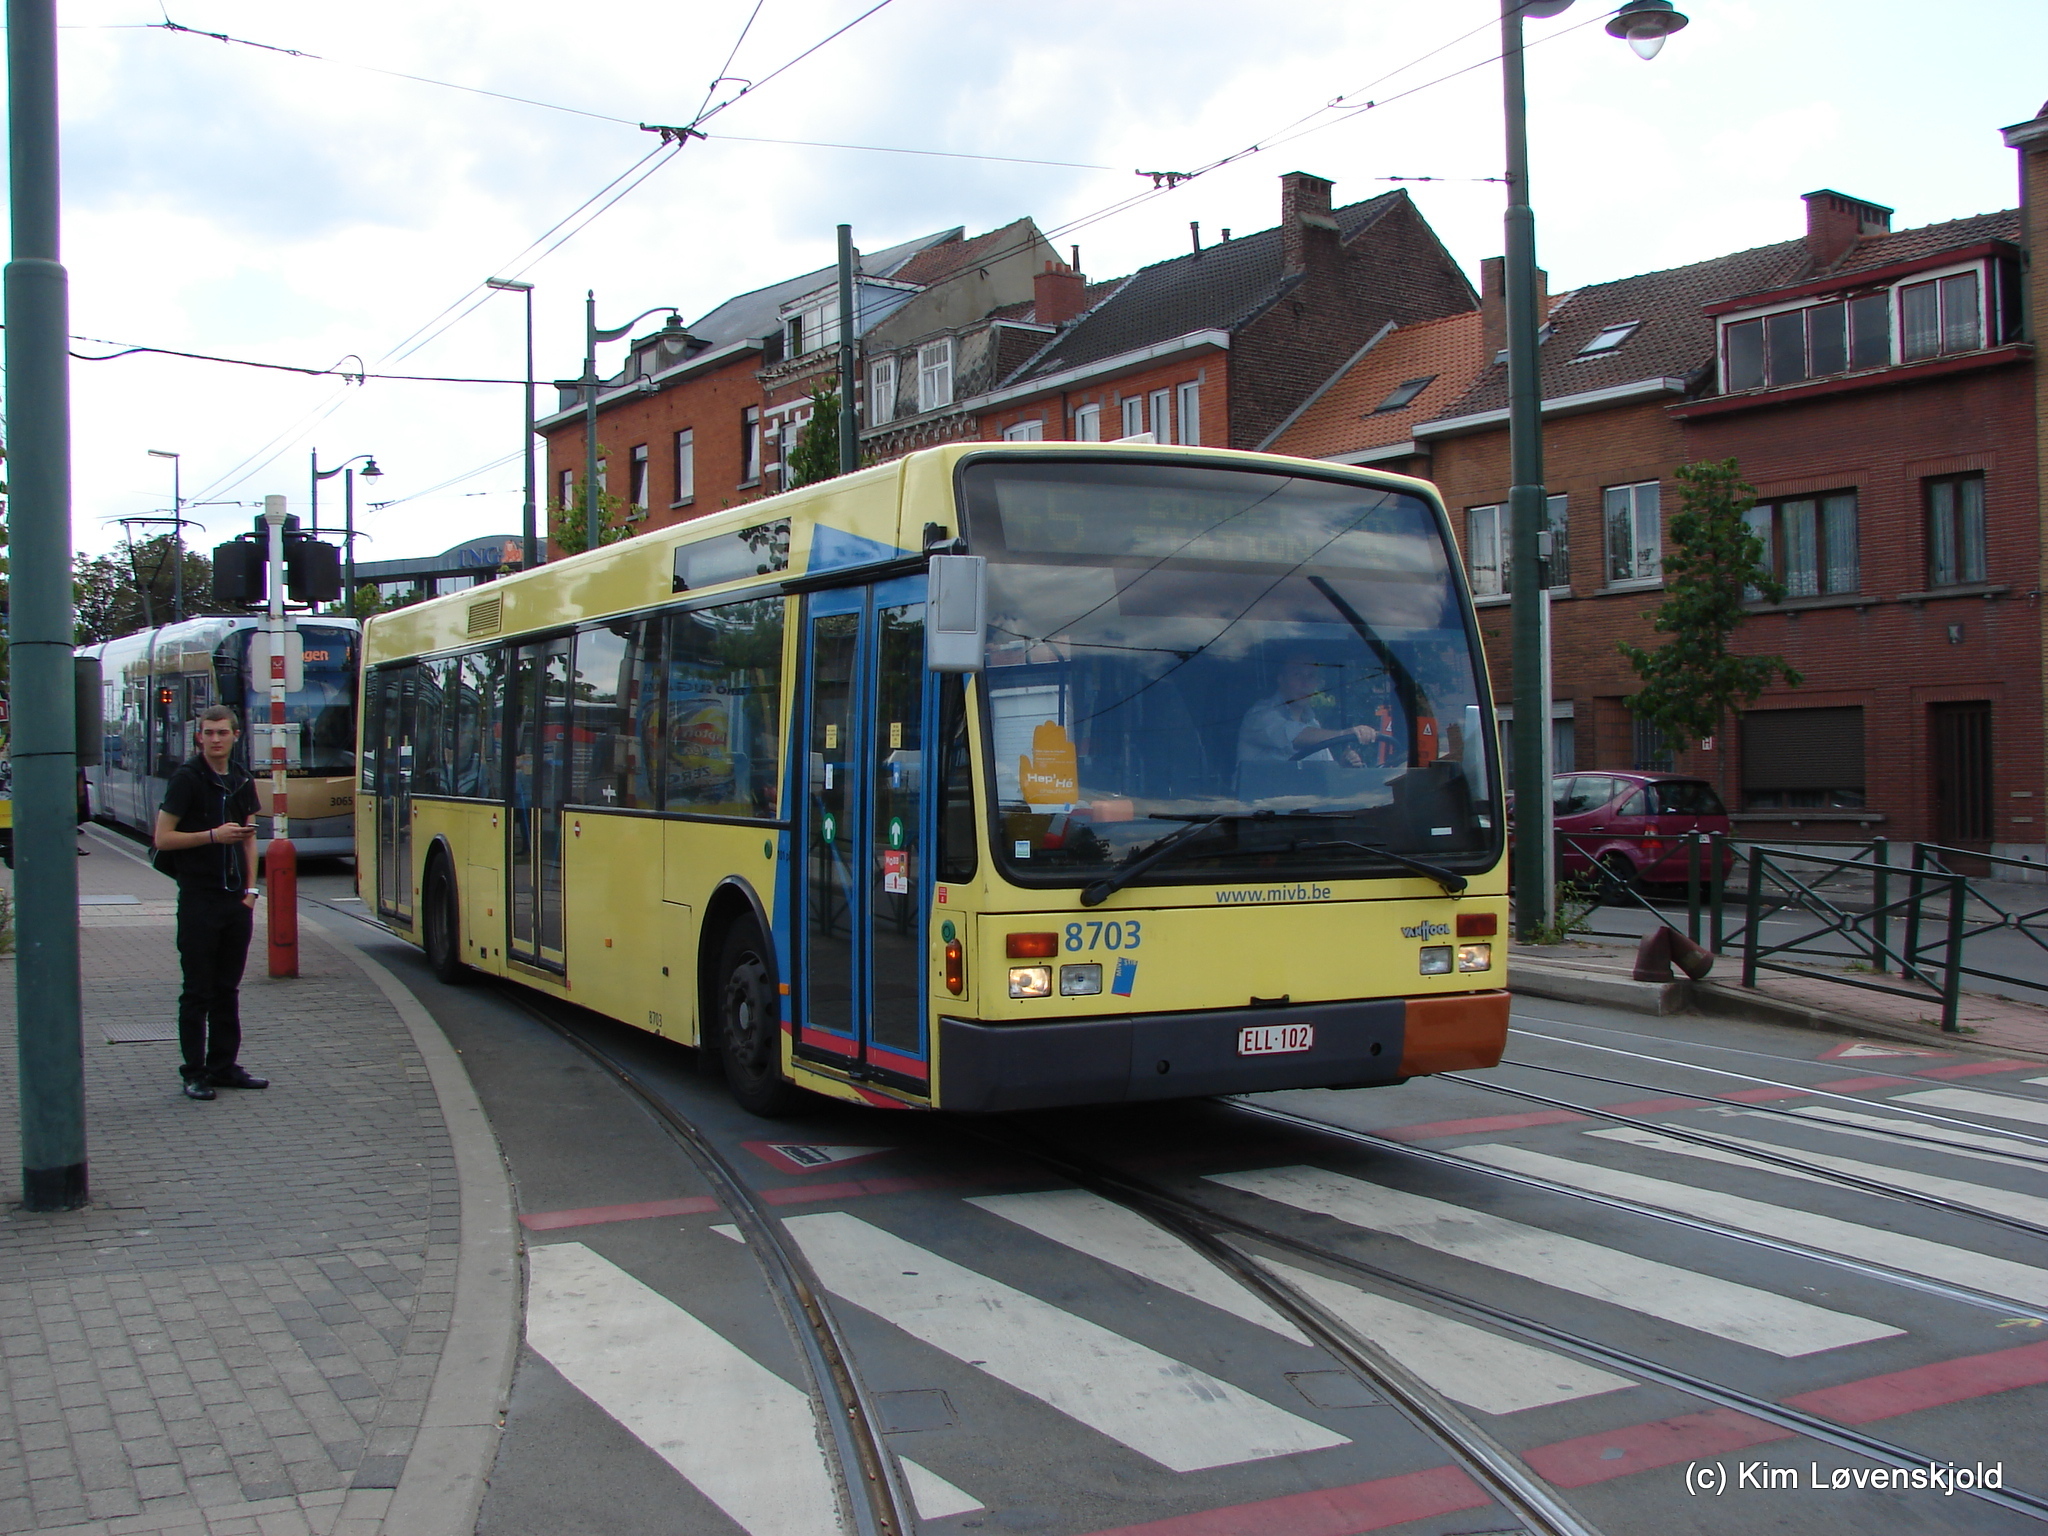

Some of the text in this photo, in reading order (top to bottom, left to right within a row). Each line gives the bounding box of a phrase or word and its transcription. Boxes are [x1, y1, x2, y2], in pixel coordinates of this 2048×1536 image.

[459, 547, 503, 567] ING
[330, 797, 353, 807] 3065
[1216, 883, 1331, 903] www.mivb.be
[1065, 920, 1141, 952] 8703
[649, 1010, 662, 1028] 8703
